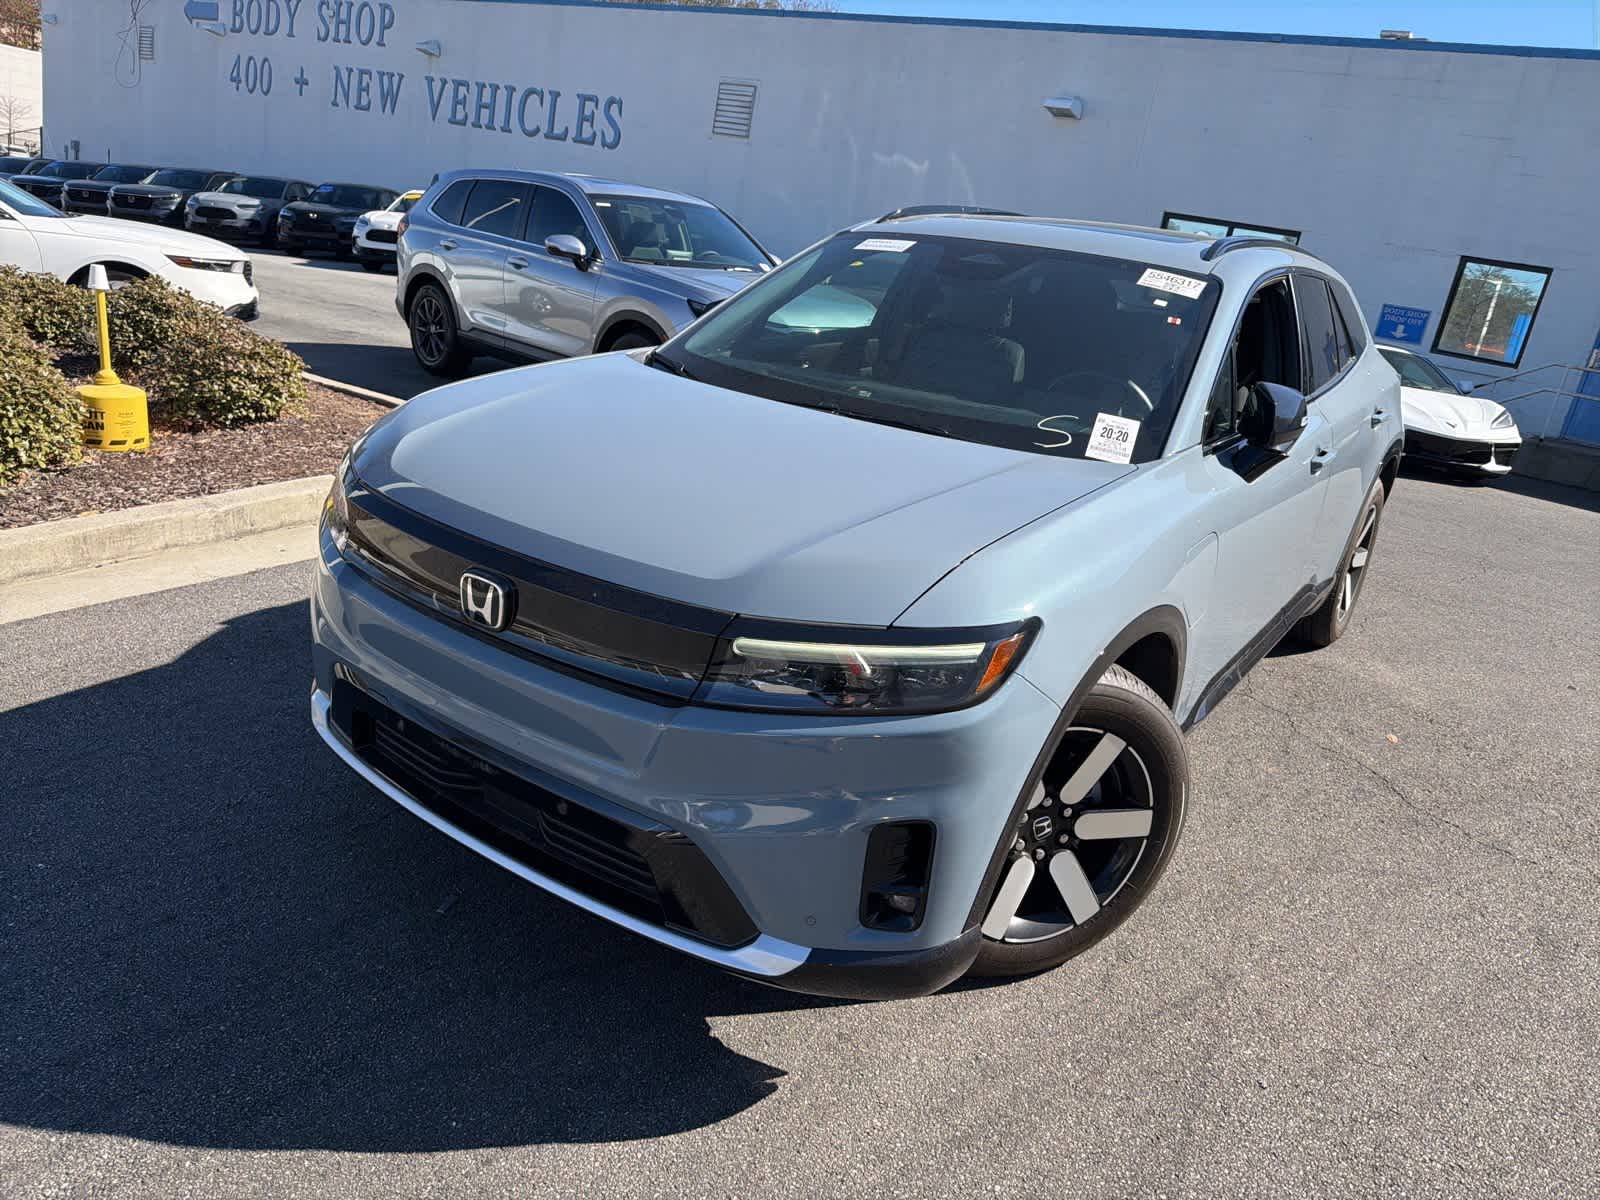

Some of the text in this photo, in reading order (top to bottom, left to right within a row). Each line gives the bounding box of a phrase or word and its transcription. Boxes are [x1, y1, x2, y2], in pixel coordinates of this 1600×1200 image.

[230, 0, 395, 47] BODY SHOP
[230, 54, 624, 150] 400 + NEW VEHICLES
[1031, 414, 1080, 448] S
[1100, 426, 1129, 443] 20:20
